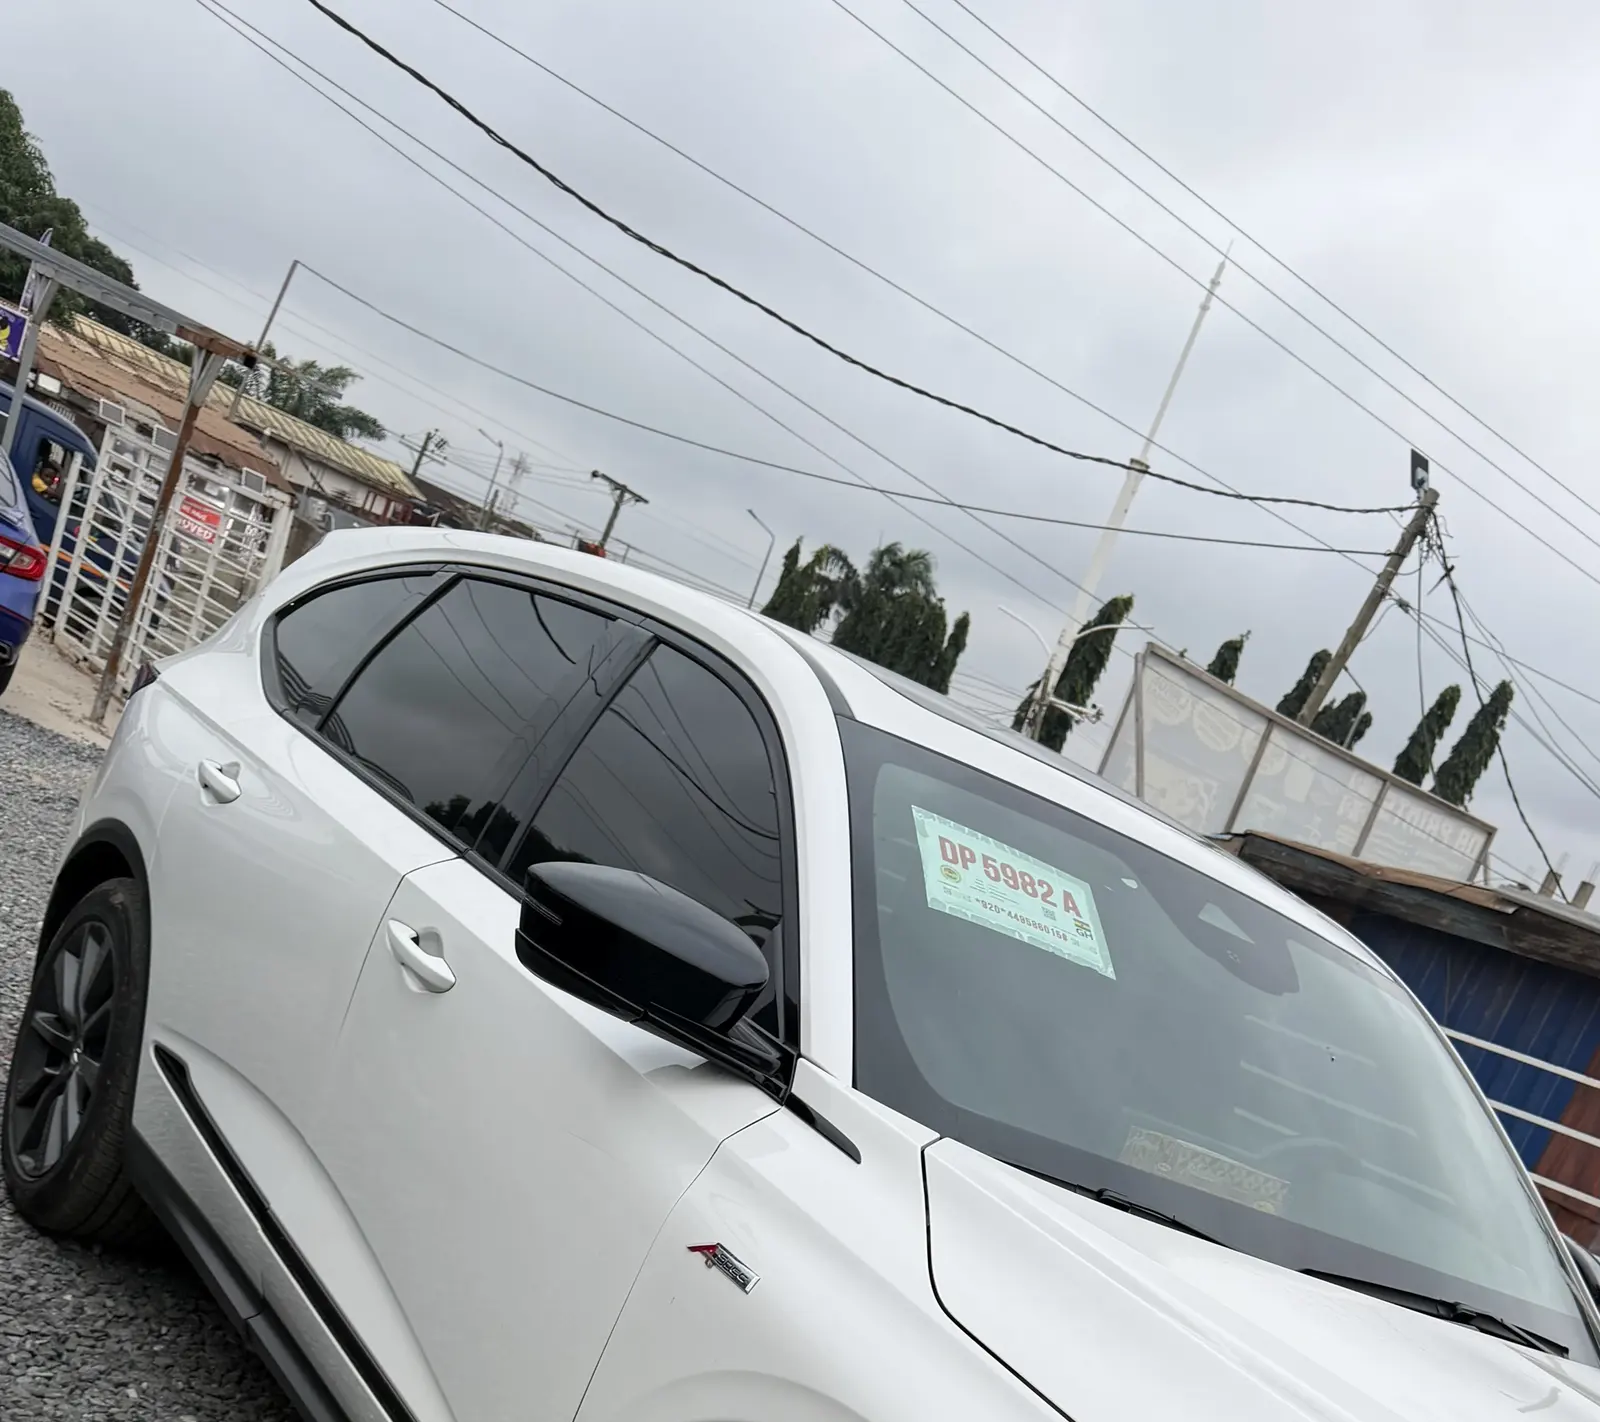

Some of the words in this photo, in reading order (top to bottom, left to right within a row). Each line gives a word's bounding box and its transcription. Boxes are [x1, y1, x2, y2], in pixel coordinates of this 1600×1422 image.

[938, 835, 976, 870] DP
[981, 853, 1058, 908] 5982
[1063, 889, 1082, 918] A
[1076, 928, 1094, 941] GH
